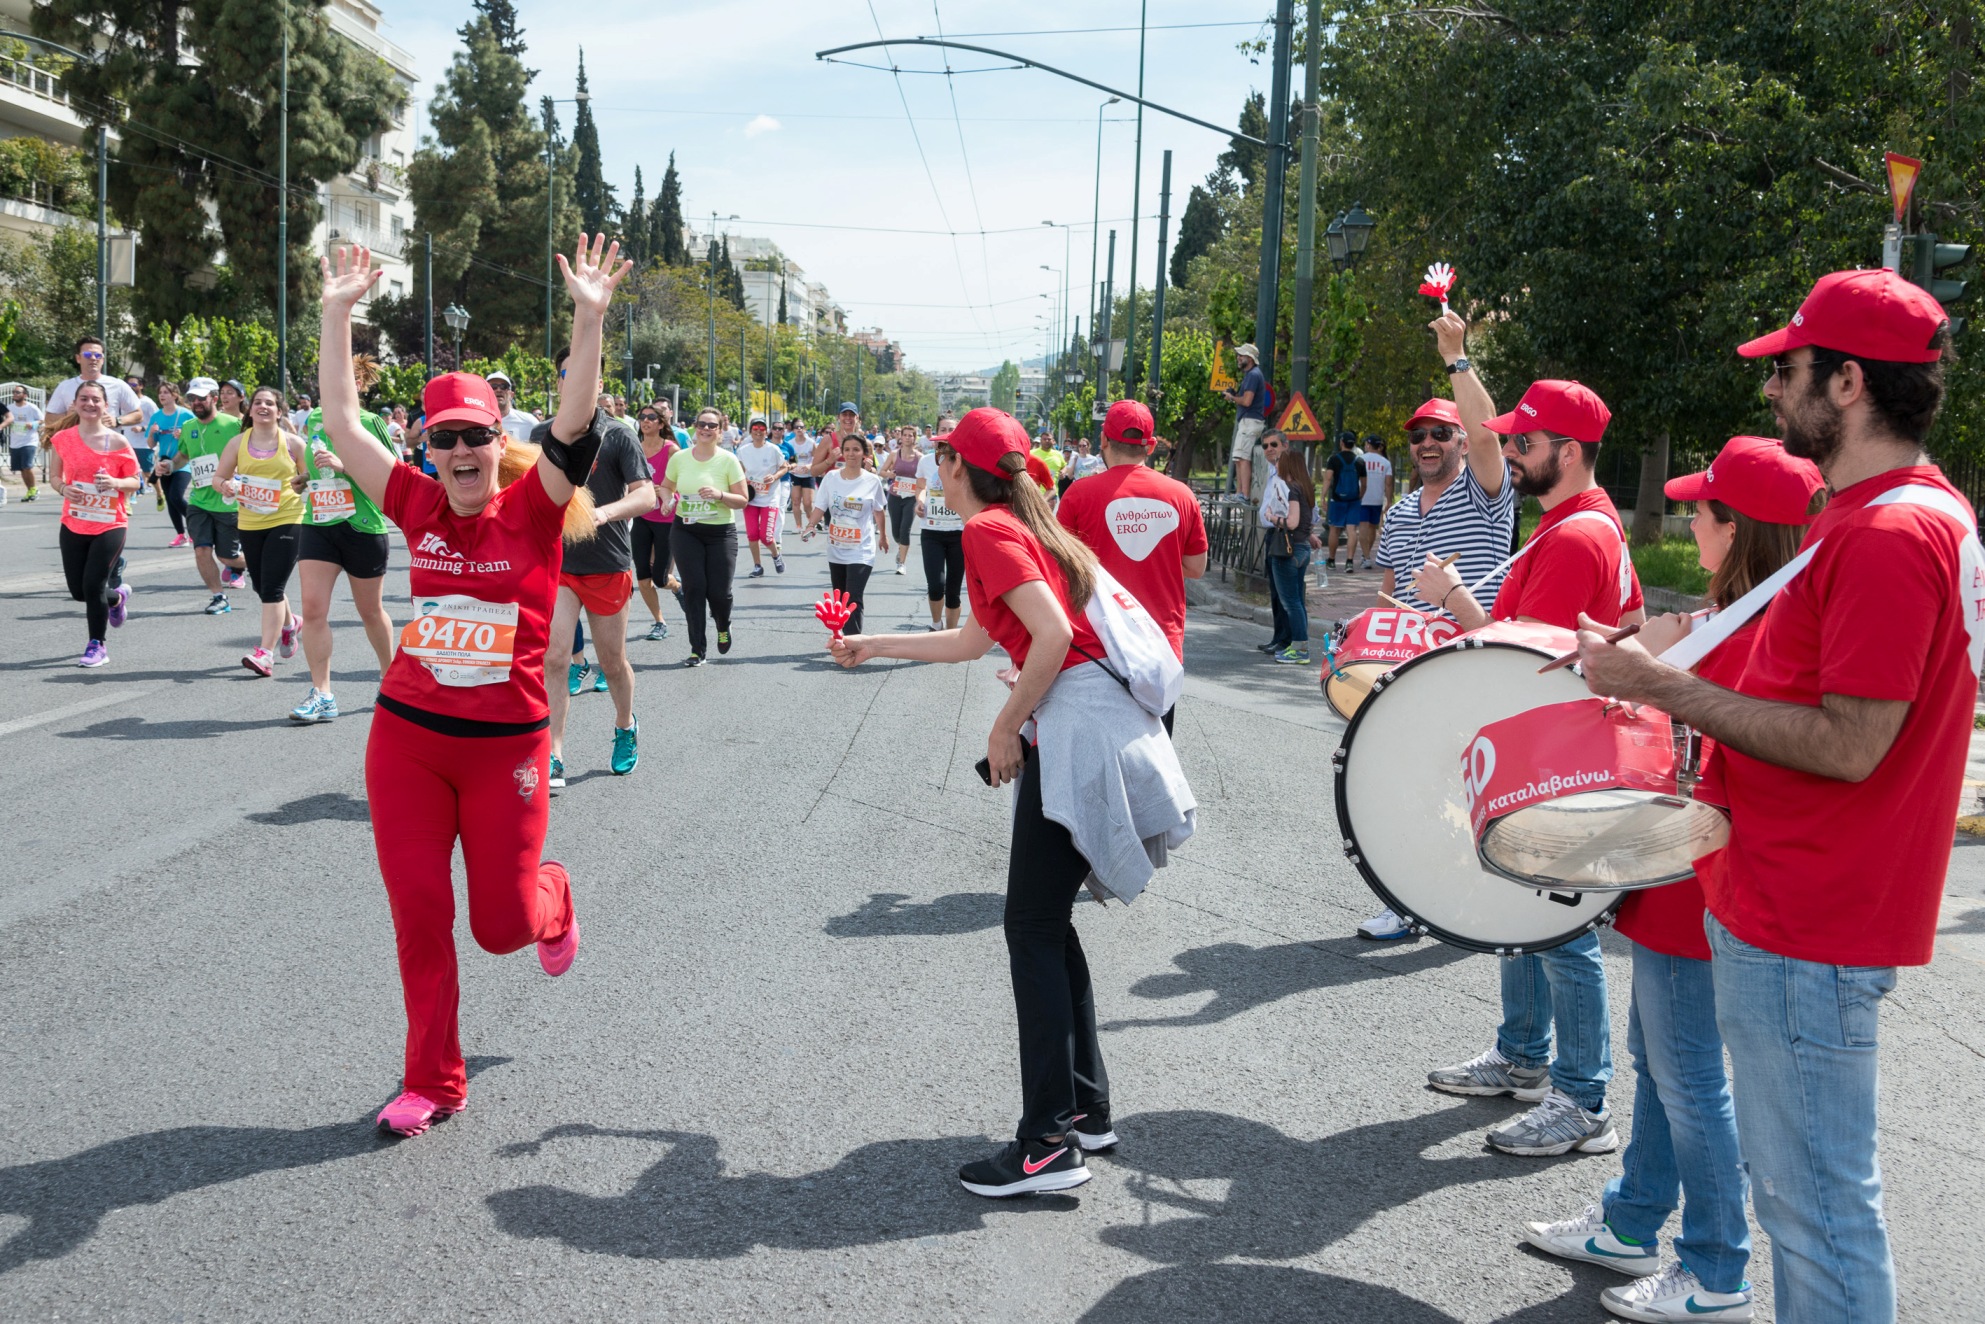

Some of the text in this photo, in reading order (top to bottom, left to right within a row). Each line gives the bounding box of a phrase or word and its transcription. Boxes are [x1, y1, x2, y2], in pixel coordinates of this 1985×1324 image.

[463, 396, 485, 408] ERGO
[1520, 402, 1537, 417] ERGO
[193, 463, 216, 477] 10142
[244, 484, 275, 502] 8860
[314, 490, 347, 506] 9468
[80, 494, 111, 509] 924
[686, 501, 711, 512] 7276
[1115, 508, 1173, 522] Ανθρώπων
[832, 526, 856, 539] 8734
[1117, 523, 1148, 534] ERGO
[411, 556, 512, 575] unning Team
[443, 603, 513, 616] ΝΙΚΗ ΤΡΑΠΕΖΑ
[417, 617, 496, 651] 9470
[1366, 611, 1457, 650] ERG
[1488, 769, 1615, 812] καταλαβαίνω.
